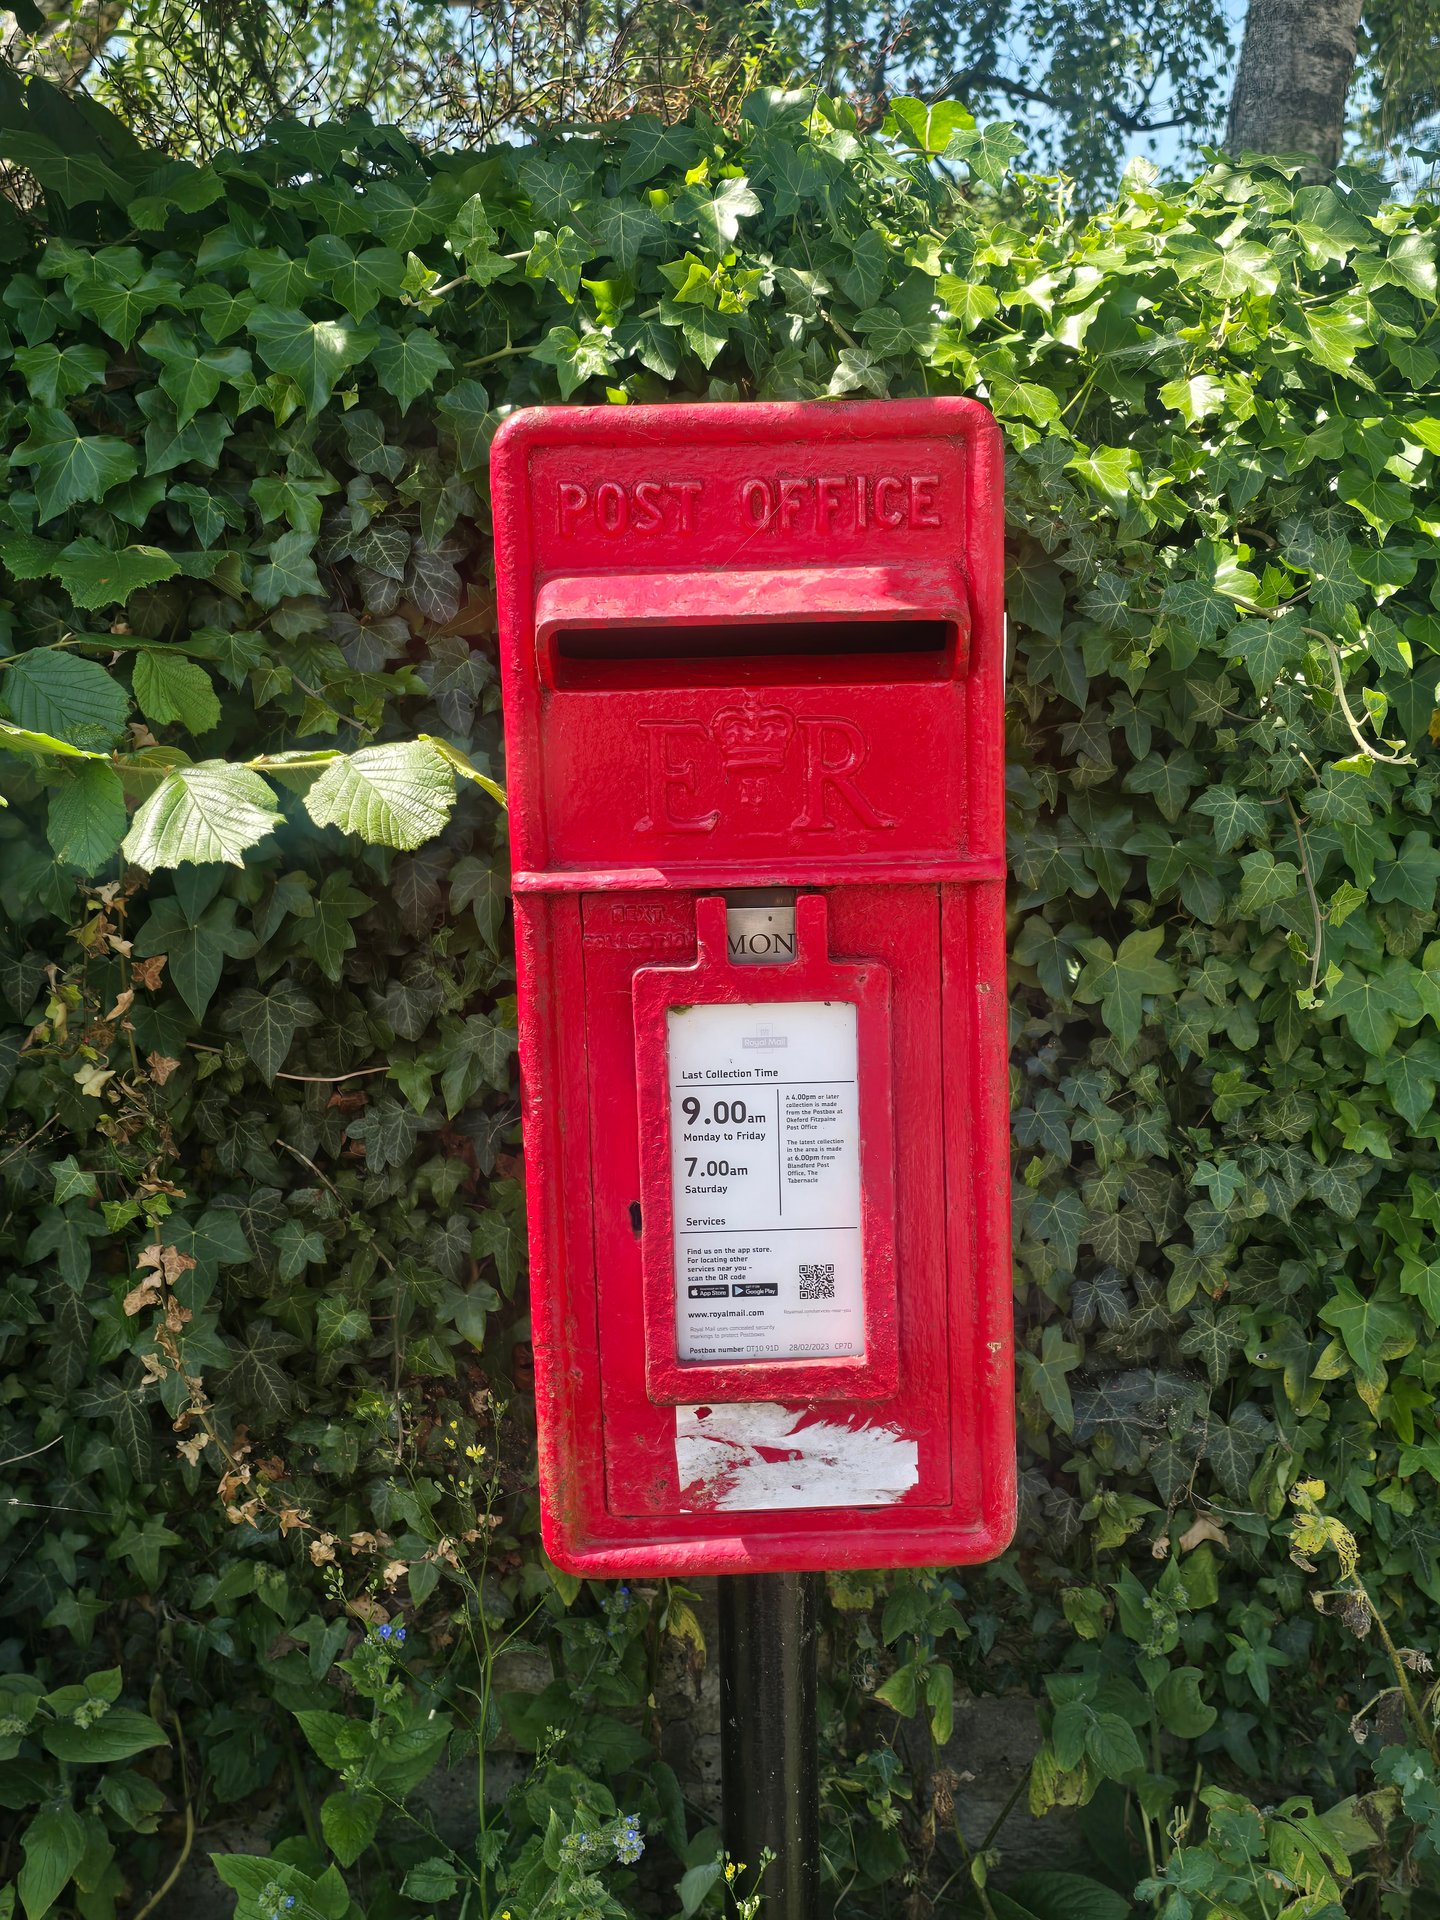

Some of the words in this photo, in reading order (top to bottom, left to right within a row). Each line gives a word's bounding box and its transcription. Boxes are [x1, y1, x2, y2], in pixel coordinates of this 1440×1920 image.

[556, 479, 704, 538] POST
[740, 474, 941, 531] OFFICE
[727, 933, 796, 955] MON
[744, 1038, 767, 1048] Royal
[768, 1038, 786, 1046] Mail
[682, 1070, 703, 1080] Last
[706, 1069, 752, 1079] Collection
[755, 1068, 779, 1078] Time
[683, 1133, 721, 1143] Monday
[724, 1133, 733, 1141] to
[736, 1131, 766, 1141] Friday
[794, 1154, 820, 1162] 6.00pm
[685, 1185, 728, 1194] Saturday
[686, 1217, 726, 1226] Services
[700, 1256, 728, 1264] locating
[687, 1265, 715, 1273] services
[734, 1265, 747, 1273] you
[718, 1273, 728, 1281] QR
[688, 1309, 765, 1319] www.royalmail.com
[789, 1343, 830, 1351] 28/02/2023
